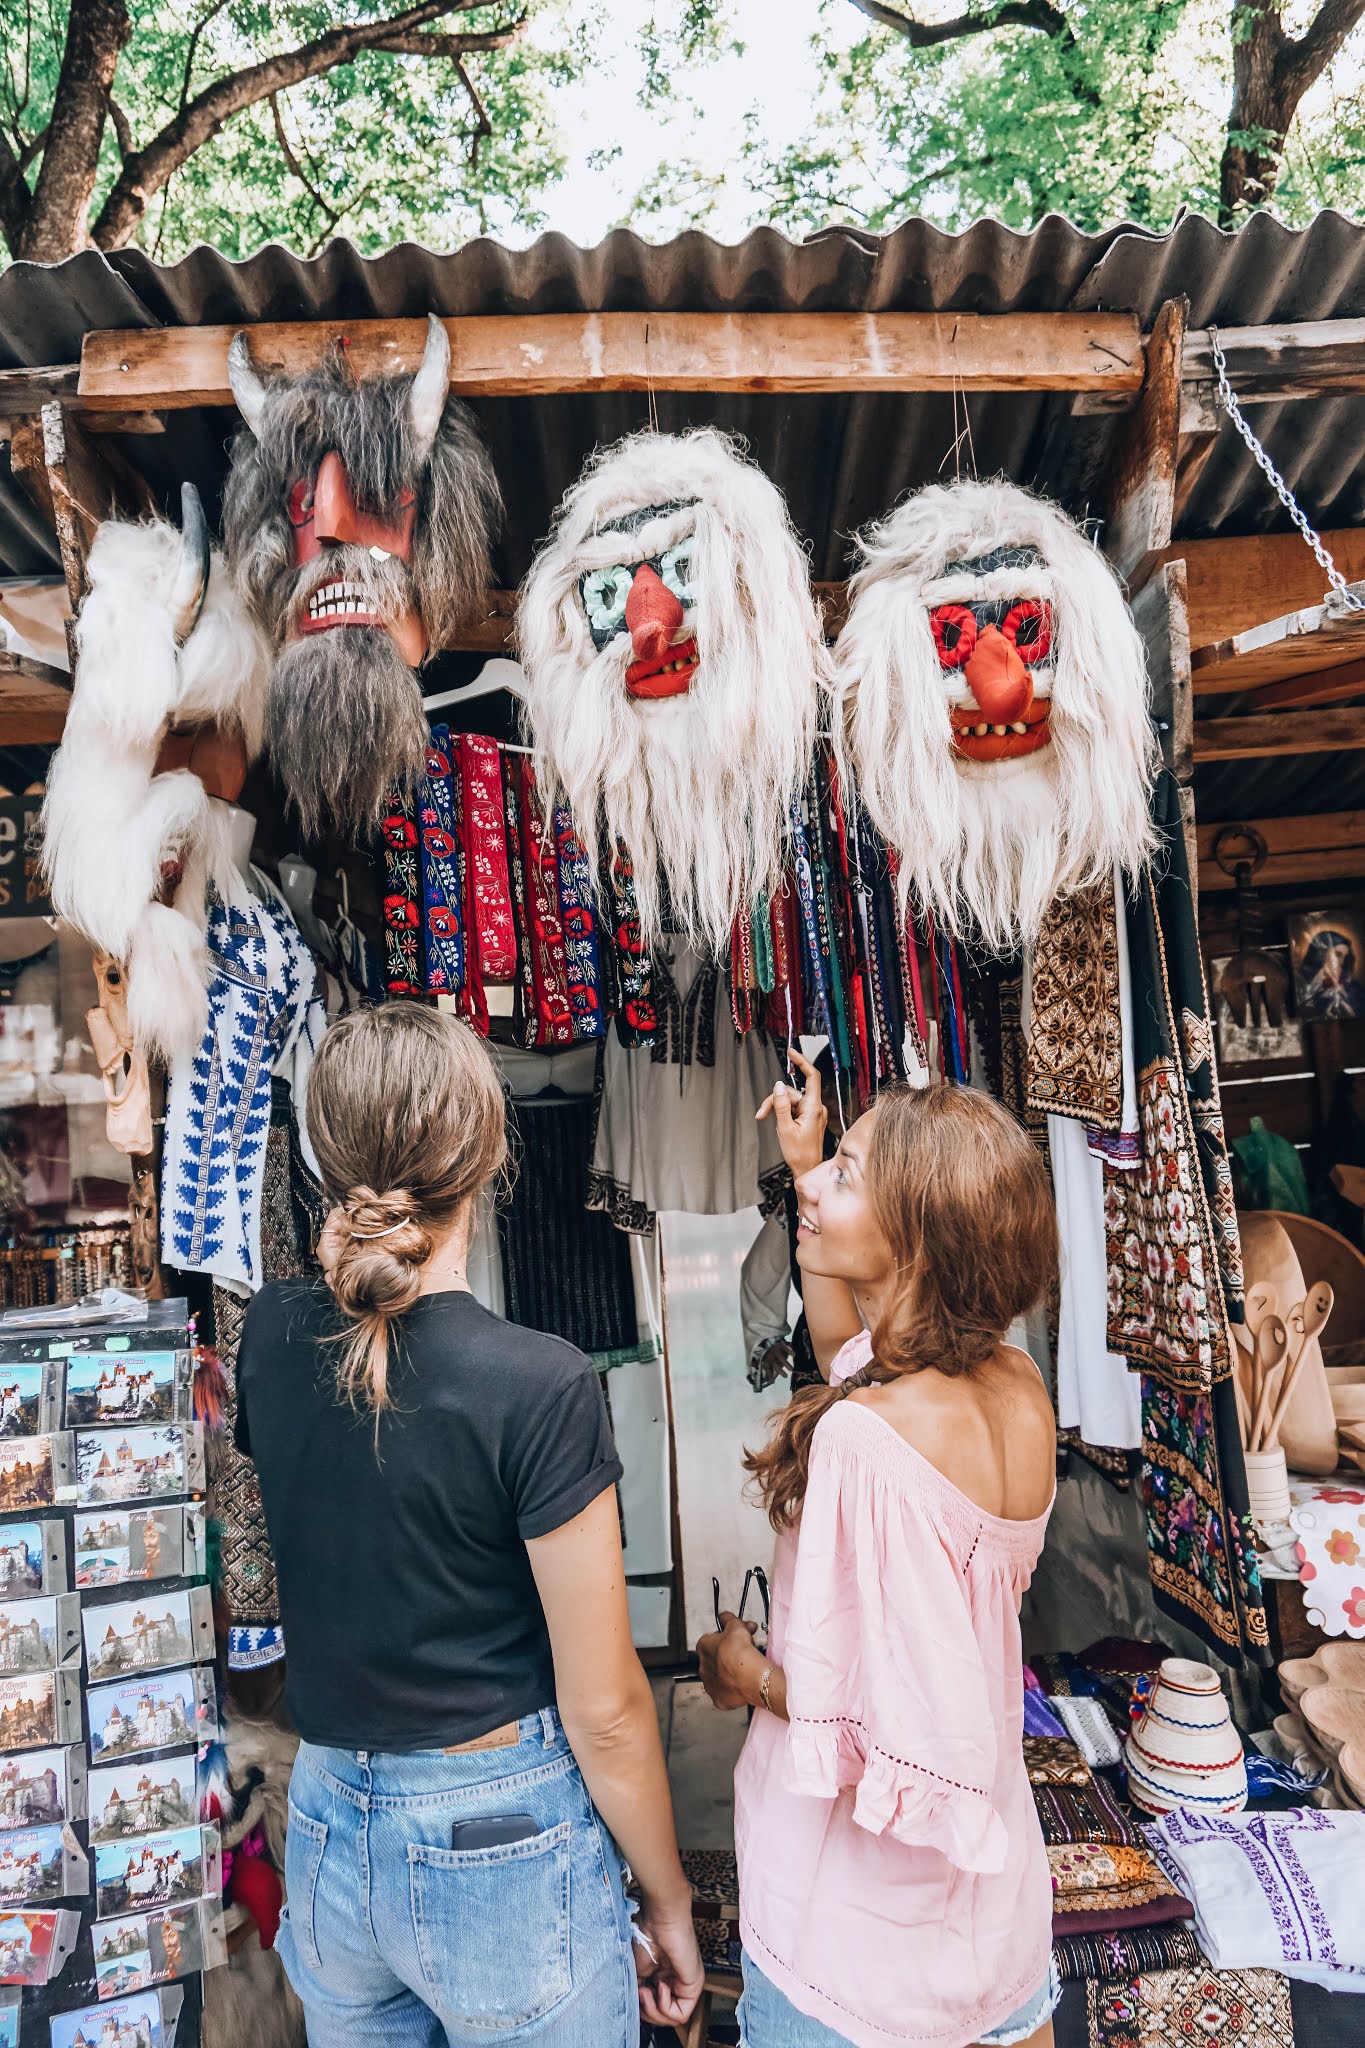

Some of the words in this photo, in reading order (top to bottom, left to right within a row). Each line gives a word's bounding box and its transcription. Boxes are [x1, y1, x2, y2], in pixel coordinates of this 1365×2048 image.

[99, 1411, 139, 1420] România
[120, 1656, 159, 1669] România
[122, 1822, 161, 1834] România
[15, 1833, 37, 1841] Bran
[130, 1896, 169, 1908] România
[111, 2006, 128, 2015] Bran
